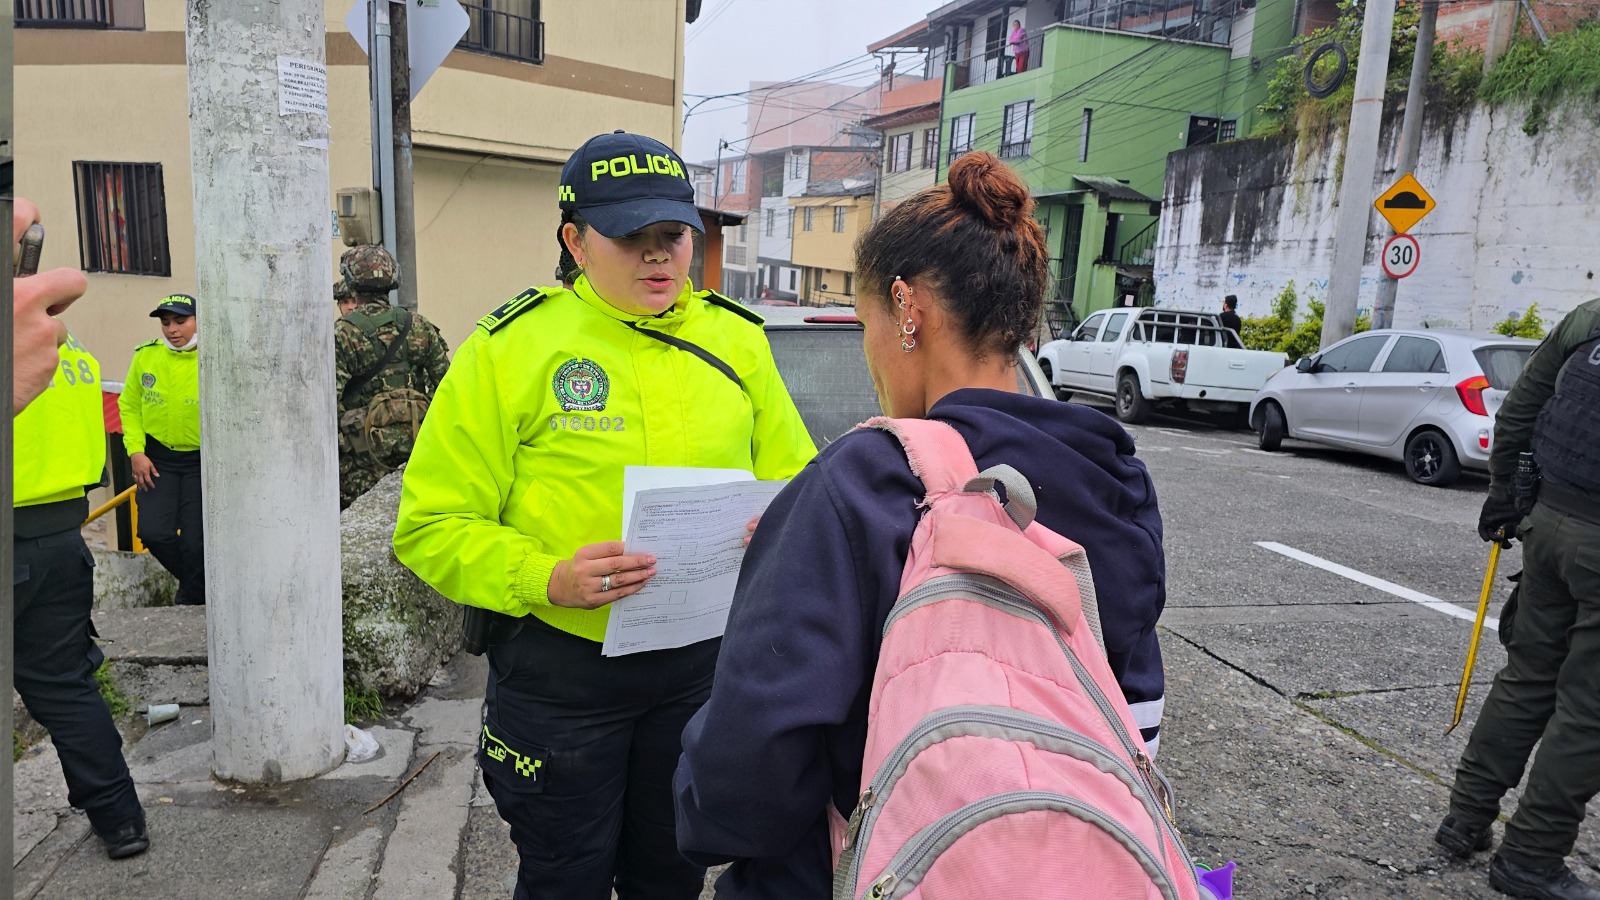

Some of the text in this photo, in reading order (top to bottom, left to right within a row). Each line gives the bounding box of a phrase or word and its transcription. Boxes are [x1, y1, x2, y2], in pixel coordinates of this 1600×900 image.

[591, 153, 686, 182] POLICÍA
[1390, 245, 1413, 265] 30
[549, 414, 625, 432] 616002
